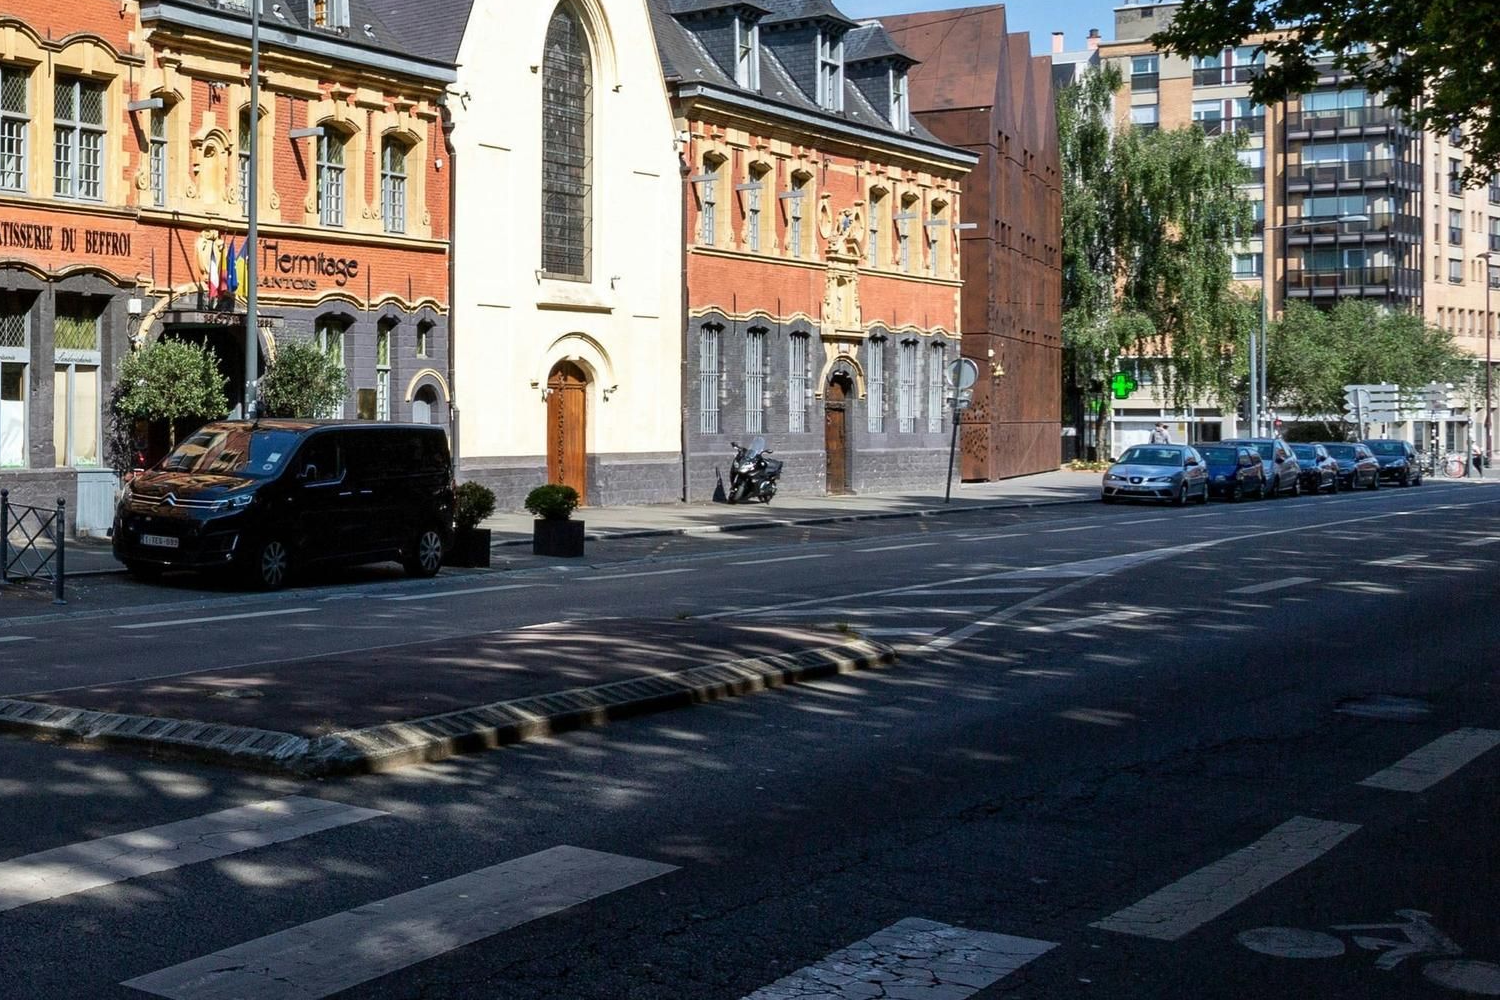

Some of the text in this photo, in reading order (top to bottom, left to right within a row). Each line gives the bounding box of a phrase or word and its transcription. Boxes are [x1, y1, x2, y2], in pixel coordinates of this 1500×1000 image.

[60, 227, 78, 253] DU
[85, 229, 132, 257] BEFFROI
[257, 276, 317, 291] ANTOIS
